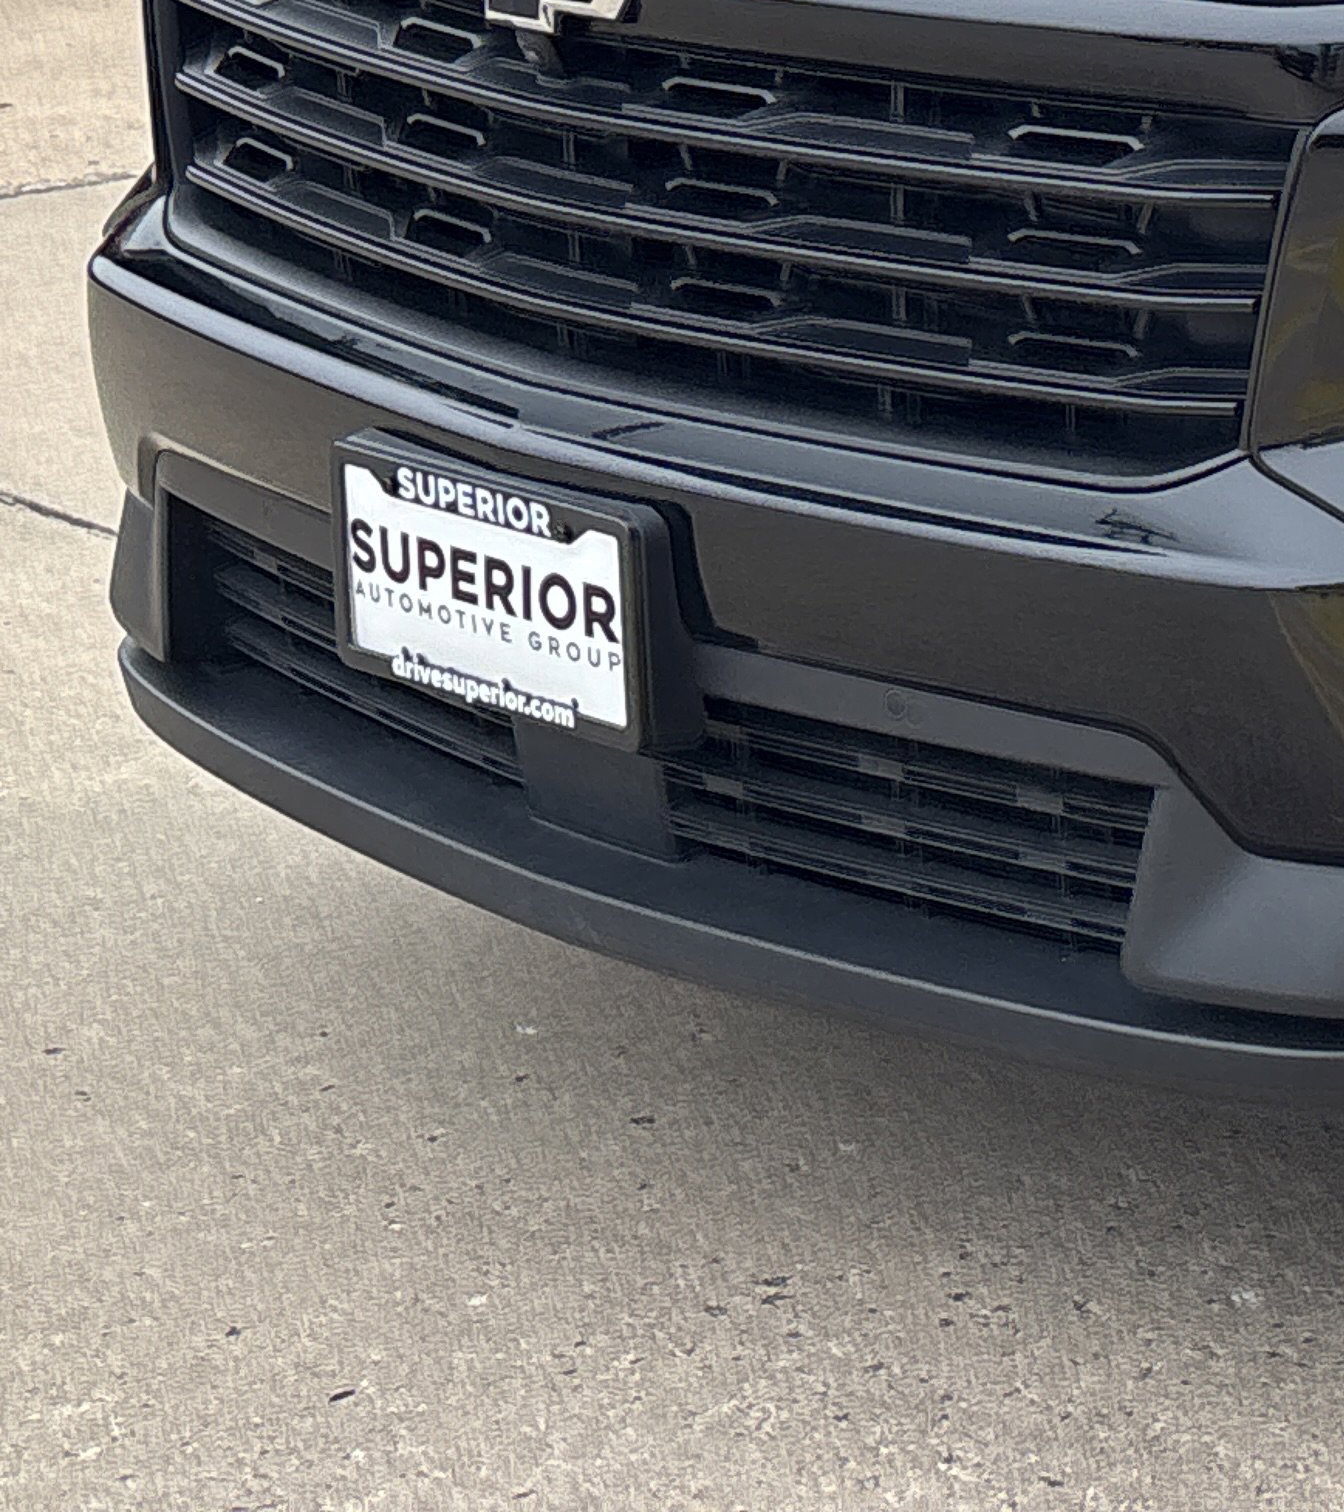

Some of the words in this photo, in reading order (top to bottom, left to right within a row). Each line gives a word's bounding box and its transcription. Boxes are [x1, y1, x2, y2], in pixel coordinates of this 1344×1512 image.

[396, 466, 552, 537] SUPERIOR
[350, 517, 620, 644] SUPERIOR
[355, 579, 513, 644] AUTOMOTIVE
[527, 631, 622, 672] GROUP
[391, 648, 576, 729] drivesuperior.com
